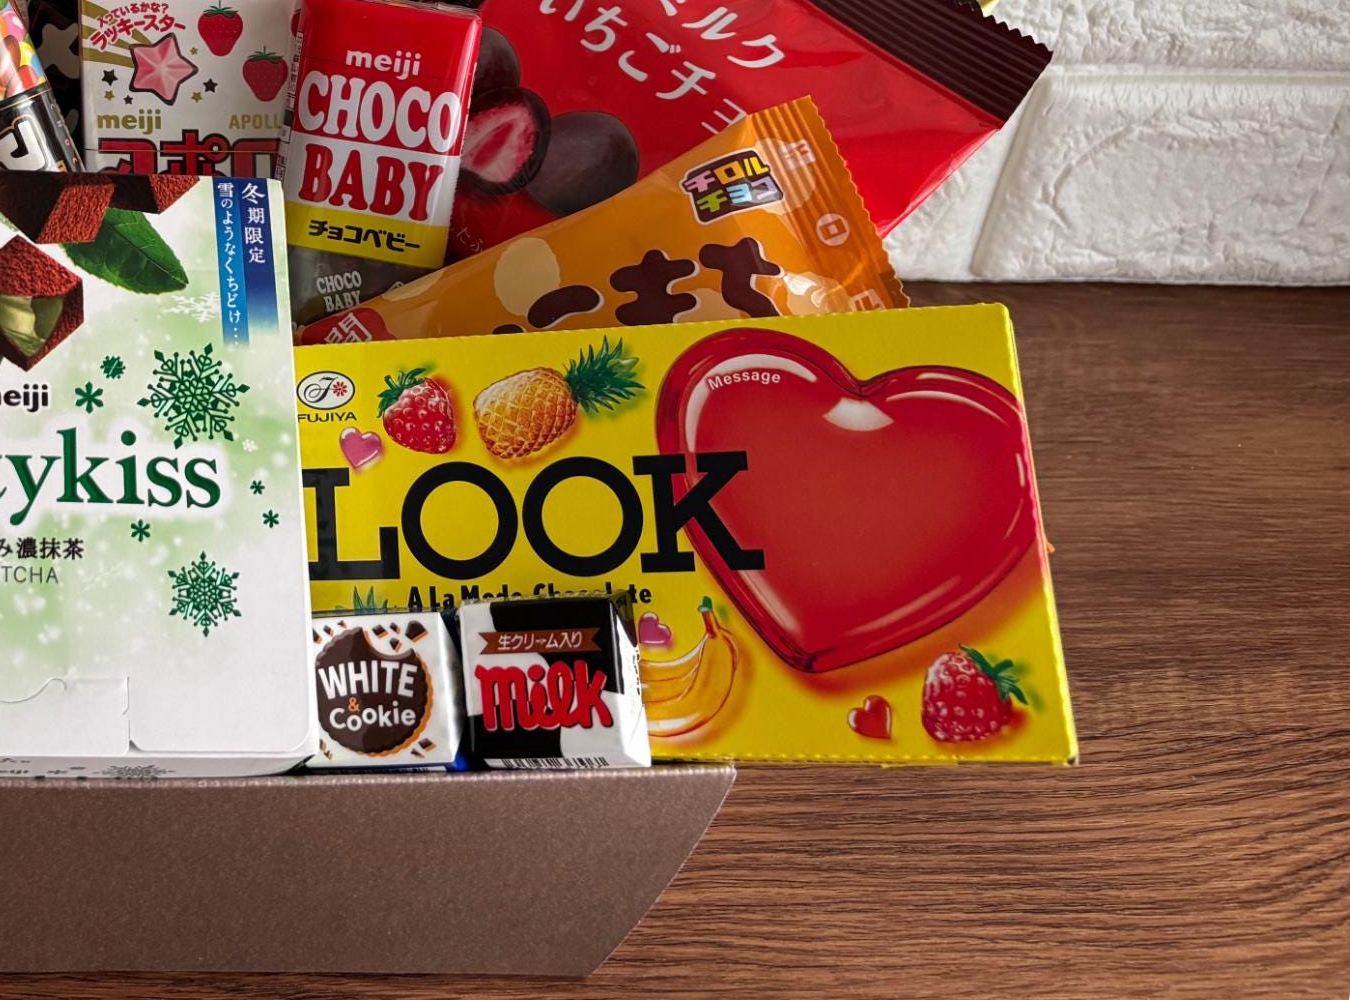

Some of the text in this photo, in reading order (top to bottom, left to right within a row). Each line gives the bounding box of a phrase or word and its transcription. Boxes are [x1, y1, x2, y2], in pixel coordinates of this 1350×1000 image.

[91, 15, 186, 50] ラッキースター
[345, 49, 421, 81] meiji
[97, 109, 162, 134] meiji
[298, 71, 461, 153] CHOCO
[299, 144, 445, 221] BABY
[684, 156, 770, 192] チロル
[697, 176, 778, 213] チョコ
[242, 182, 266, 264] 冬期限定
[309, 220, 420, 252] チョコベビー
[316, 271, 362, 294] CHOCO
[323, 290, 361, 312] BABY
[707, 371, 781, 391] Message
[297, 412, 358, 423] FUJIYA
[303, 451, 765, 581] LOOK
[407, 586, 423, 612] A
[497, 632, 583, 651] 生クリーム入り
[317, 660, 418, 701] WHITE
[329, 701, 416, 732] Cookie
